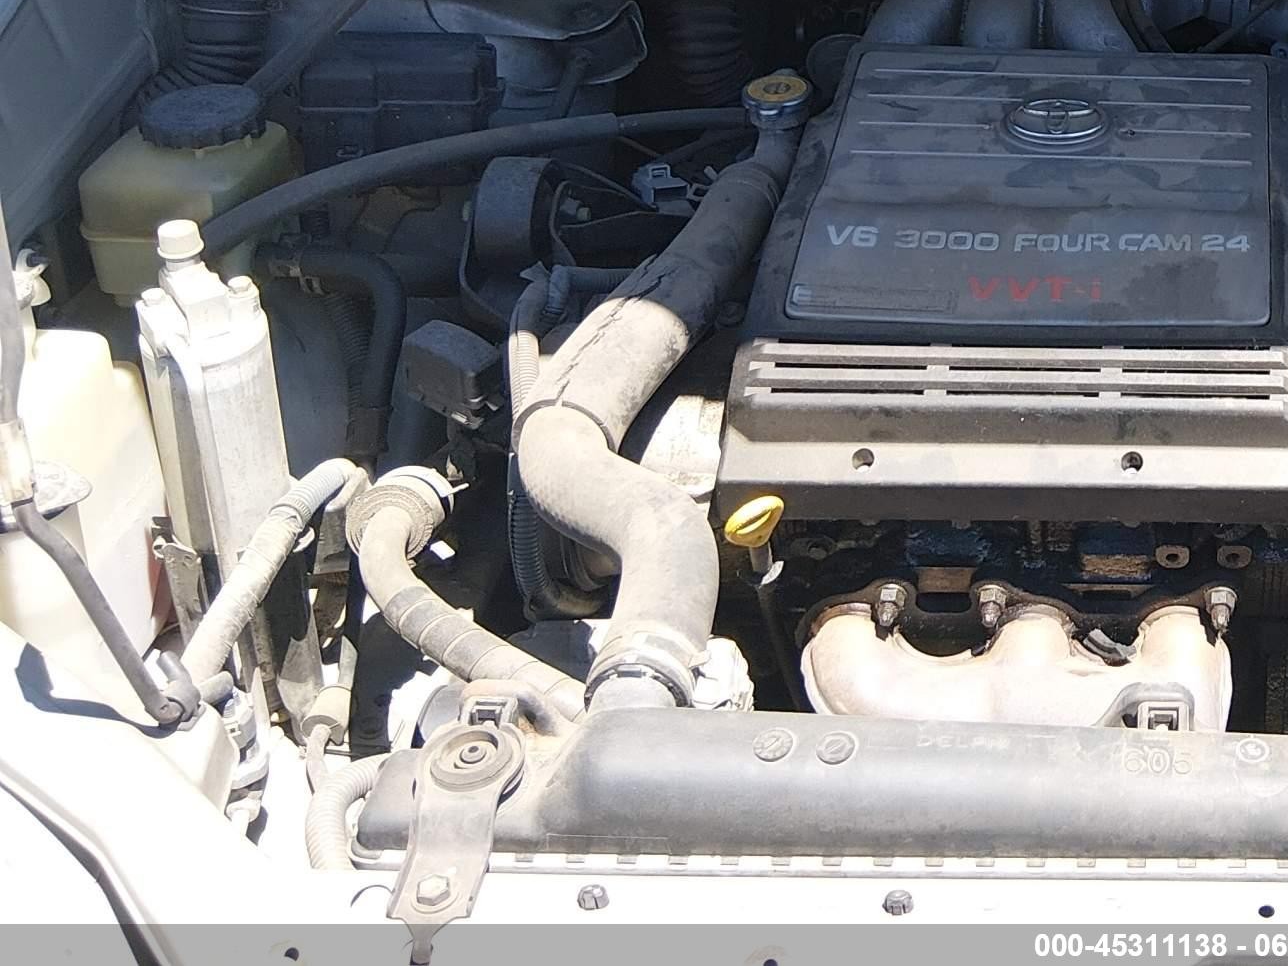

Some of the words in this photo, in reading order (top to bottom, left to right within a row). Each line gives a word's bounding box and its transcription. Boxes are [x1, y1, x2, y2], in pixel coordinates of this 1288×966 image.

[826, 225, 879, 248] V6
[894, 229, 1000, 251] 3000
[1013, 233, 1111, 253] FOUR
[1118, 233, 1192, 252] CAM
[1201, 234, 1250, 253] 24
[967, 274, 1103, 303] VVT-i
